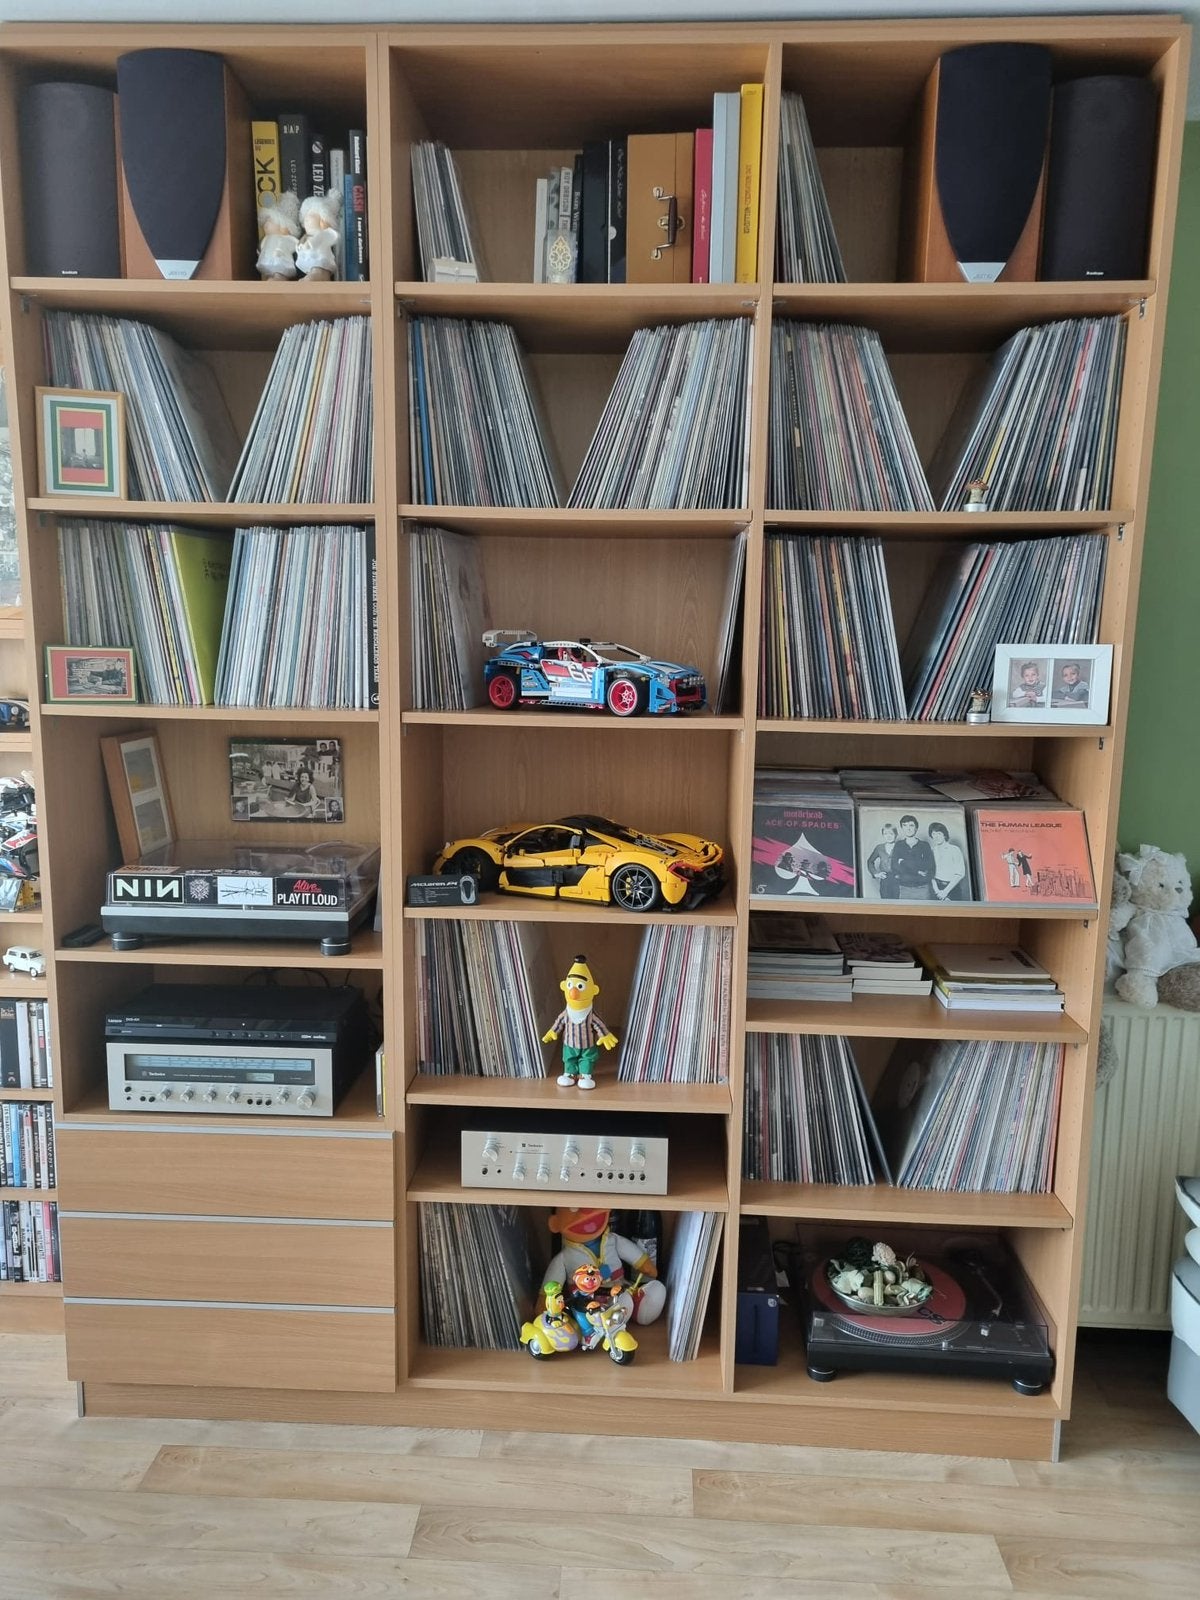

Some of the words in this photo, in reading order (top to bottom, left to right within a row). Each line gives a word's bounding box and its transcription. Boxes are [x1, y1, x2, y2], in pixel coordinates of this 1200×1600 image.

[312, 163, 324, 182] LED
[256, 158, 277, 208] OCK
[353, 185, 364, 212] CASH
[801, 821, 840, 829] SPADES
[116, 878, 179, 898] NIN
[277, 893, 302, 905] PLAY
[302, 893, 312, 905] IT
[312, 894, 338, 906] LOUD
